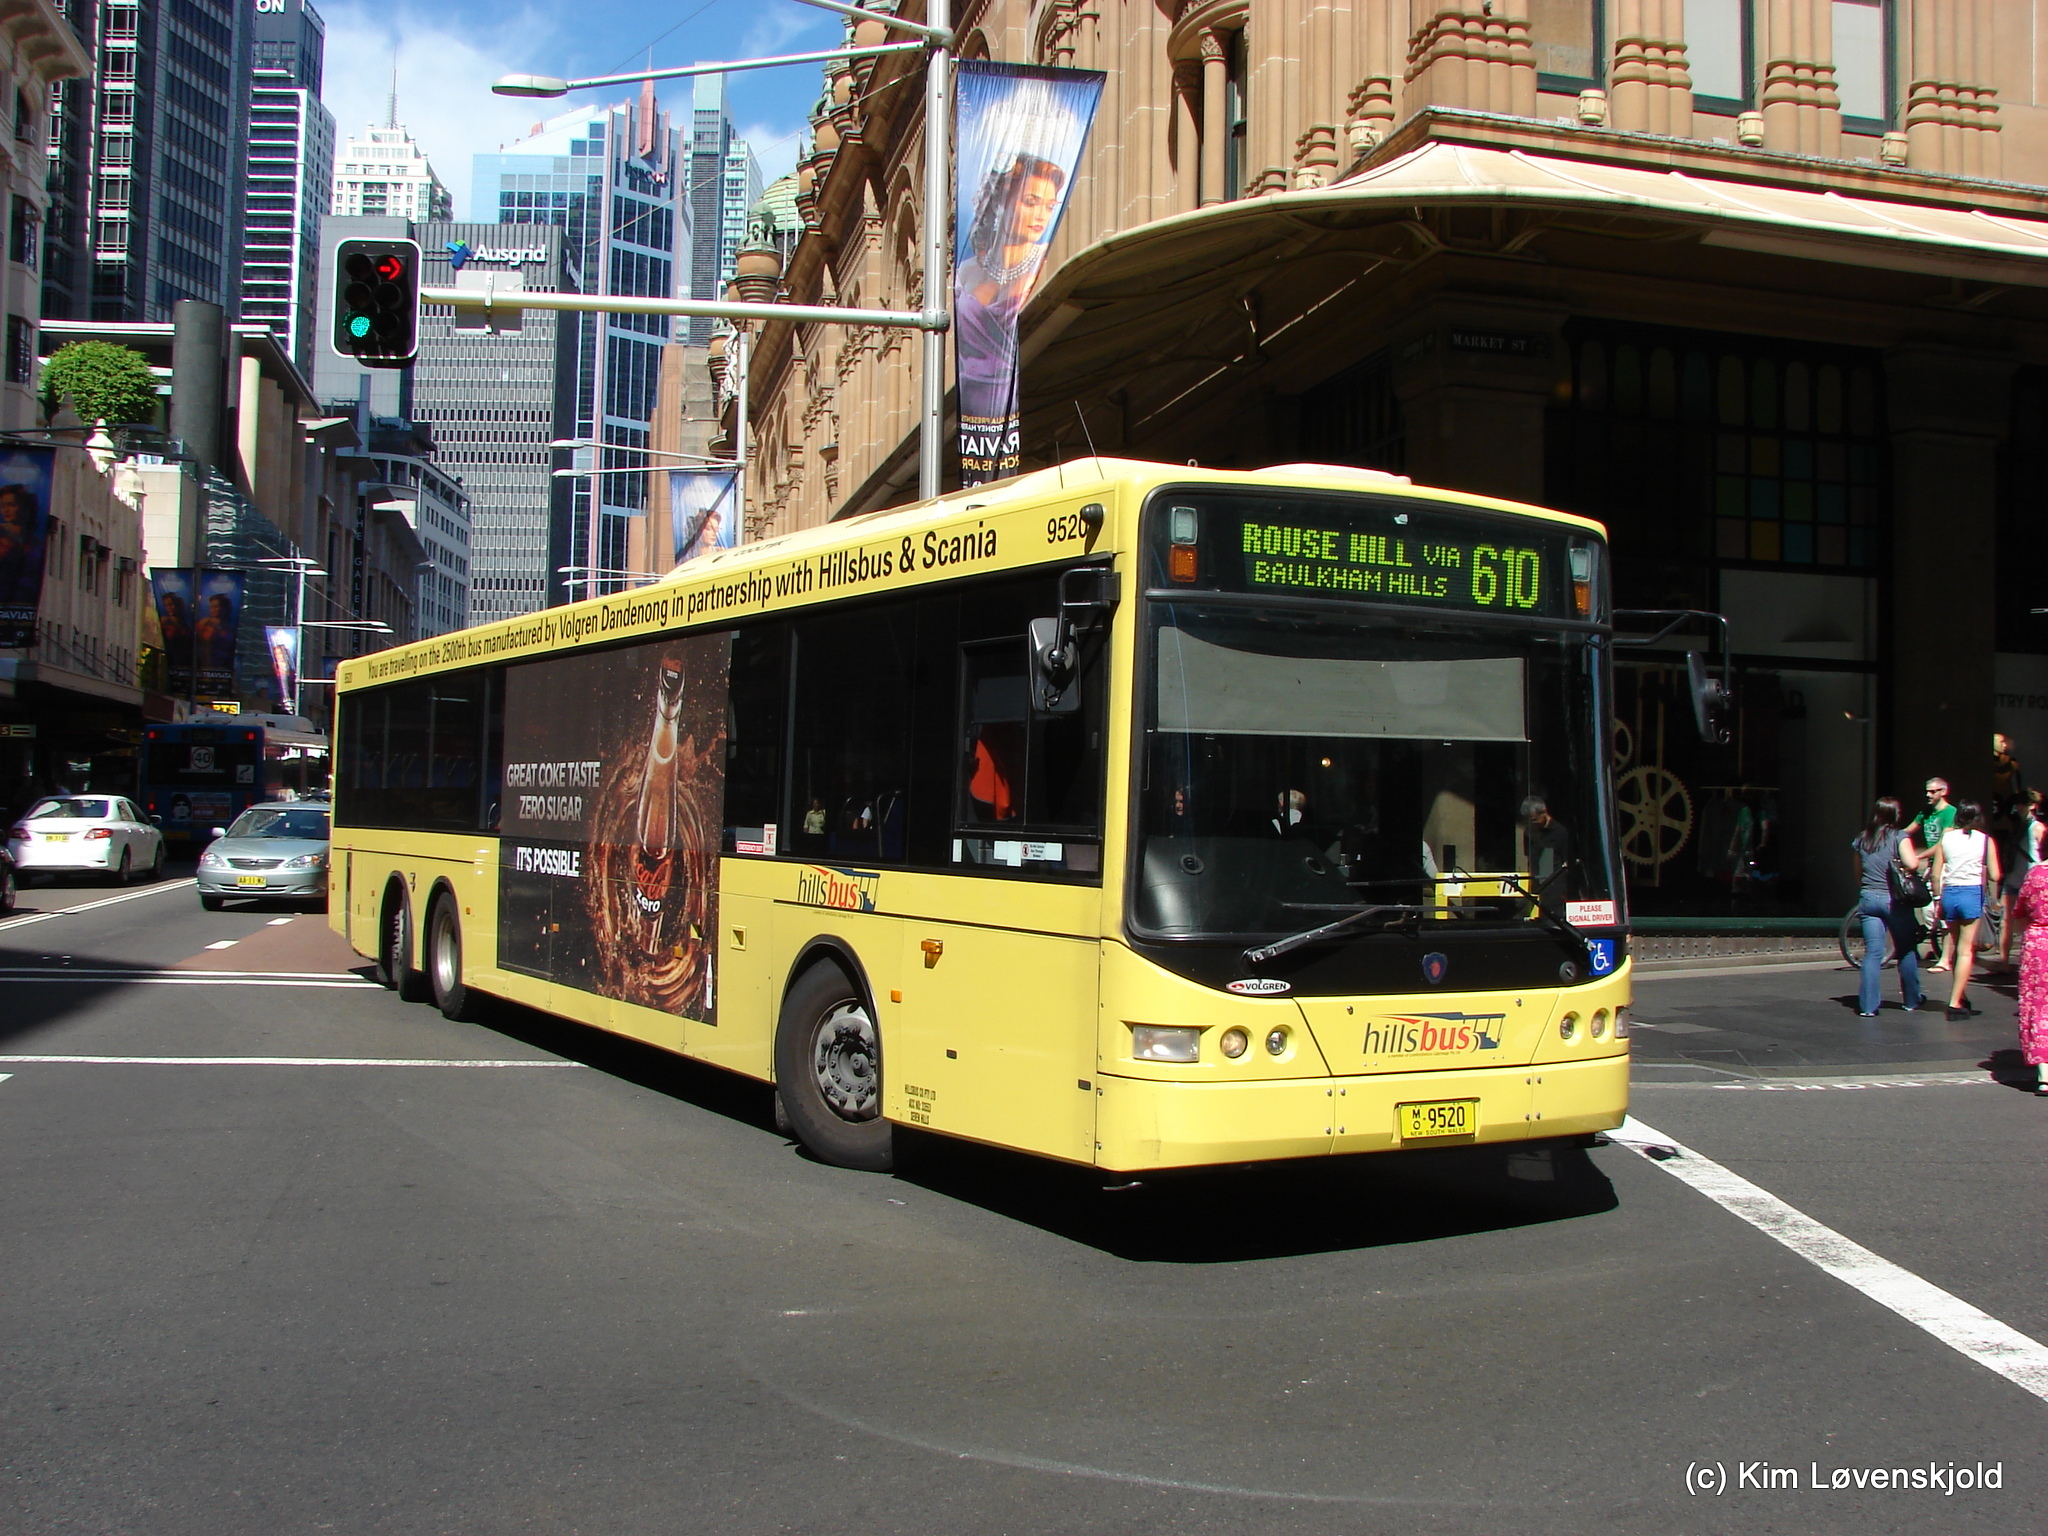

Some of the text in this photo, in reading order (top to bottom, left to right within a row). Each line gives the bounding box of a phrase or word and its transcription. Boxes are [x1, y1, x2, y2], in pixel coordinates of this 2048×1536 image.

[473, 244, 546, 266] Ausgrid
[1452, 334, 1527, 352] MARKET ST
[356, 507, 365, 541] THE
[1047, 513, 1087, 544] 9520
[1243, 523, 1461, 568] ROUSE HILL VIA
[1254, 560, 1447, 597] BAULKHAM HILLS
[1471, 543, 1540, 609] 610
[352, 557, 363, 654] GALERES
[368, 661, 378, 680] You
[379, 662, 388, 677] are
[390, 650, 418, 674] travelling
[418, 652, 428, 668] on
[429, 646, 441, 666] the
[442, 638, 466, 663] 2500th
[468, 636, 482, 658] bus
[484, 619, 542, 654] manufactured
[544, 616, 557, 646] by
[560, 612, 598, 642] Volgren
[602, 598, 668, 632] Dandenong
[672, 589, 684, 618] in
[688, 570, 772, 622] partnership
[776, 560, 812, 598] with
[819, 547, 893, 590] Hillsbus
[900, 536, 915, 574] &
[922, 520, 997, 568] Scania
[1994, 693, 2048, 710] TRY RO
[194, 752, 211, 764] 40
[506, 762, 600, 788] GREAT COKE TASTE
[519, 796, 582, 822] ZERO SUGAR
[516, 847, 580, 878] IT'S POSSIBLE
[636, 887, 660, 912] zero
[797, 870, 858, 908] hillsbus
[1568, 914, 1612, 922] SIGNAL DRIVER
[1580, 904, 1602, 912] PLEASE
[1246, 982, 1287, 990] VOLGREN
[1362, 1020, 1471, 1054] hillsbus
[1428, 1106, 1465, 1129] 9520
